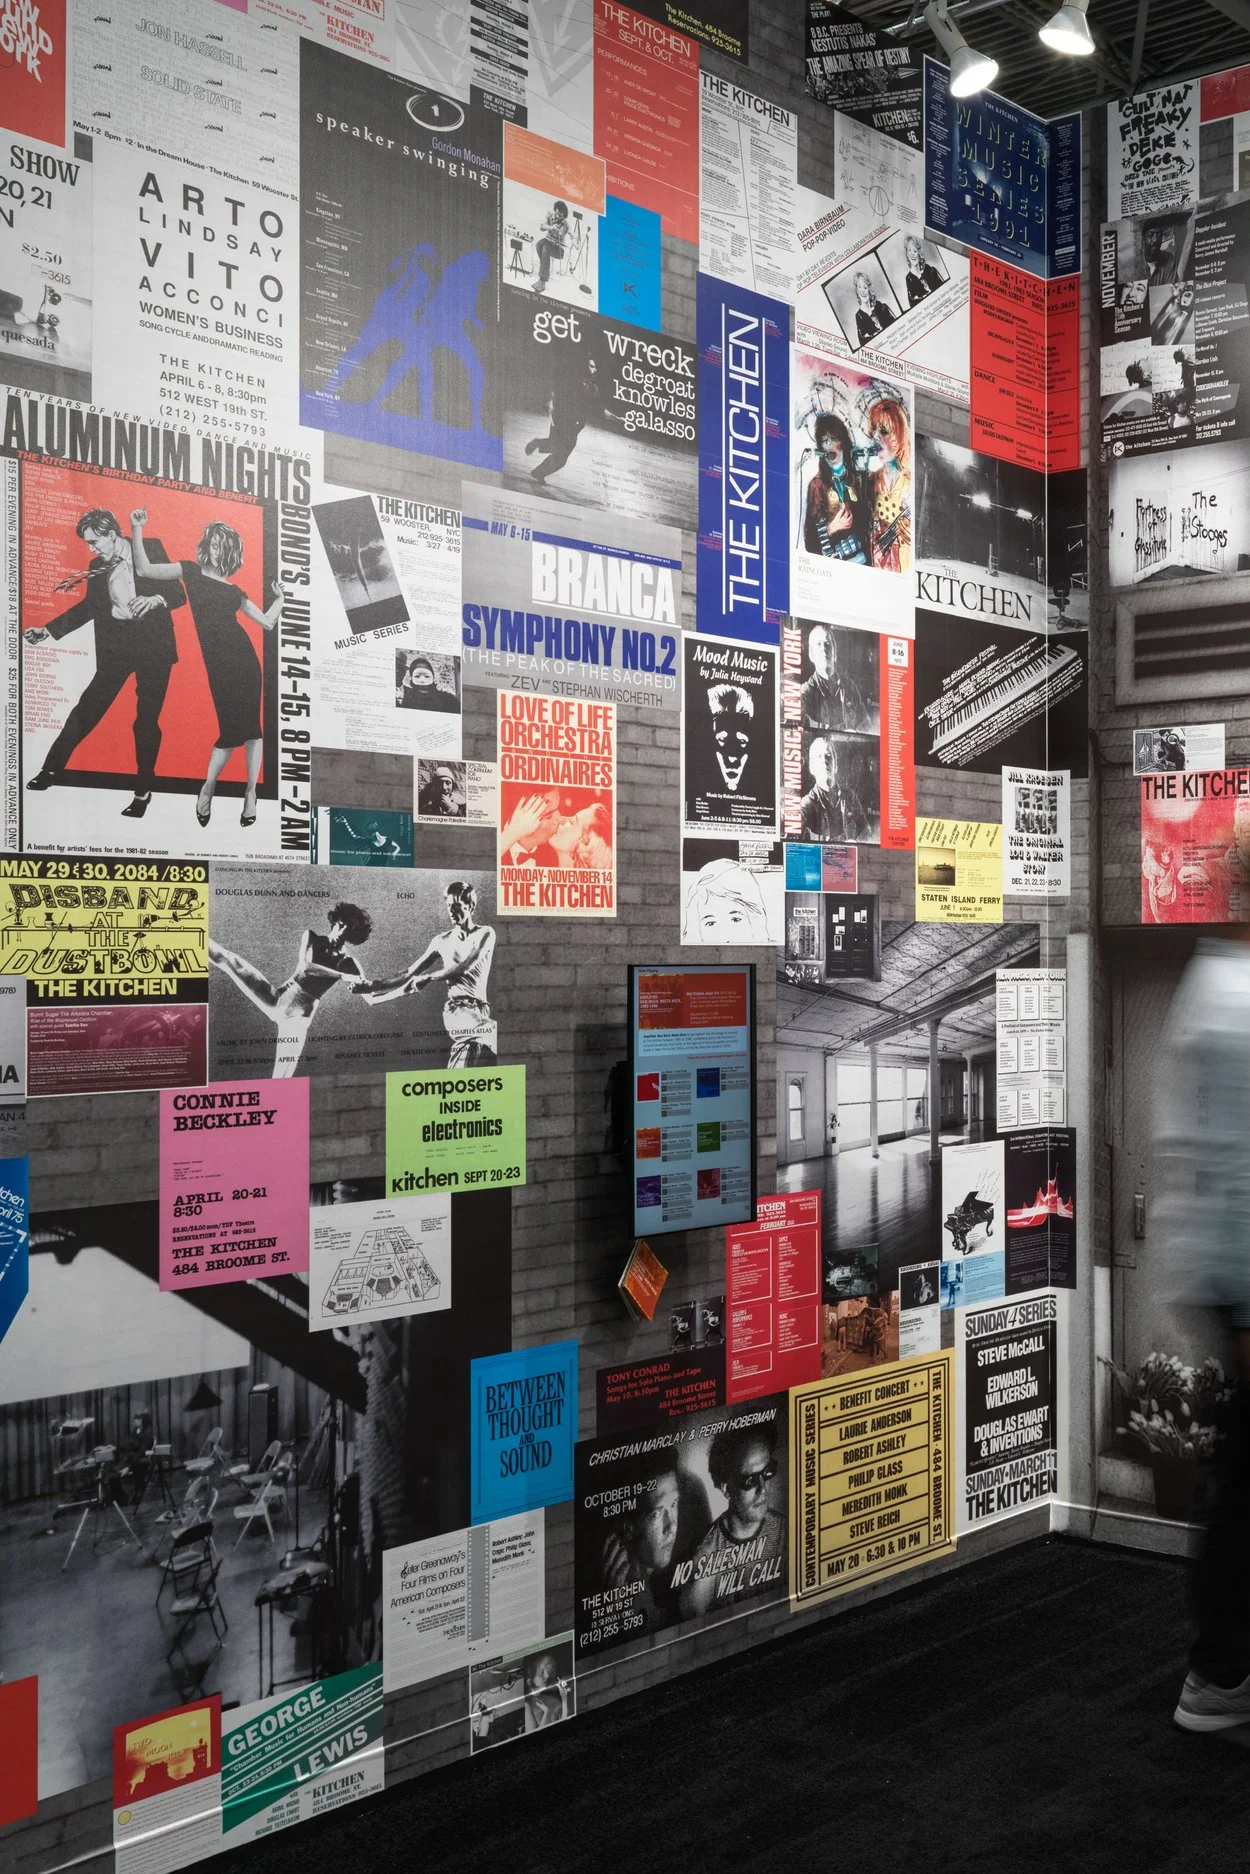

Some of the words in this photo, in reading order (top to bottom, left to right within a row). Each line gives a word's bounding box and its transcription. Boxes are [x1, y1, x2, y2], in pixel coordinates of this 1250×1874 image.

[135, 19, 172, 43] JON
[173, 28, 247, 72] HASSELL
[601, 1, 631, 29] THE
[634, 16, 692, 56] KITCHEN
[140, 66, 190, 96] SOLID
[193, 84, 242, 114] STATE
[9, 145, 80, 187] SHOW
[316, 112, 395, 150] speaker
[403, 144, 490, 189] swinging
[432, 137, 462, 159] Gordon
[463, 148, 499, 171] Monahan
[962, 136, 1039, 192] MUSIC
[139, 173, 284, 238] ARTO
[798, 222, 812, 241] DARA
[812, 204, 845, 233] BIRNBAUM
[21, 242, 62, 266] $2.50
[139, 207, 282, 262] LINDSAY
[140, 238, 284, 303] VITO
[139, 277, 283, 327] ACCONCI
[139, 301, 209, 330] WOMEN'S
[215, 320, 283, 349] BUSINESS
[533, 311, 581, 344] get
[604, 330, 695, 378] wreck
[613, 379, 696, 420] knowles
[622, 362, 696, 400] degroat
[160, 388, 180, 402] 512
[184, 393, 218, 409] WEST
[223, 403, 246, 416] 19th
[250, 409, 267, 421] ST.
[624, 408, 696, 441] galasso
[729, 309, 759, 511] KITCHEN
[4, 395, 190, 482] ALUMINUM
[202, 438, 311, 506] NIGHTS
[280, 502, 311, 585] BOND'S
[533, 545, 676, 624] BRANCA
[729, 524, 759, 611] THE
[915, 570, 1032, 621] KITCHEN
[280, 592, 311, 651] JUNE
[462, 604, 616, 665] SYMPHONY
[693, 646, 728, 667] Mood
[731, 651, 768, 673] Music
[783, 627, 802, 677] YORK
[511, 674, 539, 691] ZEV
[552, 682, 600, 699] STEPHAN
[603, 688, 662, 706] WISCHERTH
[783, 681, 802, 721] NEW
[501, 694, 549, 724] LOVE
[552, 698, 574, 726] OF
[578, 702, 612, 730] LIFE
[501, 722, 612, 755] ORCHESTRA
[501, 754, 612, 787] ORDINAIRES
[1143, 776, 1177, 800] THE
[785, 793, 802, 836] NEW
[8, 883, 201, 911] DISBAND
[215, 888, 251, 897] DOUGLAS
[254, 889, 278, 897] DUNN
[297, 890, 330, 898] DANCERS
[602, 872, 612, 885] 14
[922, 894, 948, 903] STATEN
[951, 896, 976, 904] ISLAND
[980, 896, 1001, 904] FERRY
[0, 946, 208, 976] DUSTBOWL
[173, 1092, 260, 1111] CONNIE
[402, 1076, 503, 1099] composers
[440, 1100, 481, 1114] INSIDE
[173, 1110, 277, 1132] BECKLEY
[422, 1117, 503, 1143] electronics
[174, 1189, 223, 1206] APRIL
[232, 1188, 268, 1199] 20-21
[392, 1169, 458, 1193] kitchen
[464, 1170, 487, 1184] SEPT
[490, 1167, 521, 1182] 20-23
[978, 1344, 1006, 1366] STEVE
[1009, 1336, 1045, 1357] McCALL
[485, 1370, 565, 1414] BETWEEN
[840, 1388, 872, 1410] BENEFIT
[875, 1380, 911, 1402] CONCERT
[487, 1400, 564, 1440] THOUGHT
[589, 1443, 641, 1466] CHRISTIAN
[642, 1430, 685, 1453] MARCLAY
[688, 1428, 694, 1440] &
[699, 1421, 729, 1438] PERRY
[729, 1409, 776, 1430] HOBERMAN
[805, 1403, 816, 1445] SERIES
[500, 1445, 552, 1478] SOUND
[805, 1447, 816, 1488] MUSIC
[848, 1469, 875, 1489] PHILIP
[877, 1461, 903, 1481] GLASS
[585, 1488, 629, 1509] OCTOBER
[805, 1491, 816, 1587] CONTEMPORARY
[671, 1561, 692, 1588] NO
[694, 1537, 766, 1581] SALESMAN
[717, 1568, 746, 1597] WILL
[749, 1556, 781, 1586] CALL
[228, 1686, 326, 1755] GEORGE
[294, 1724, 368, 1780] LEWIS
